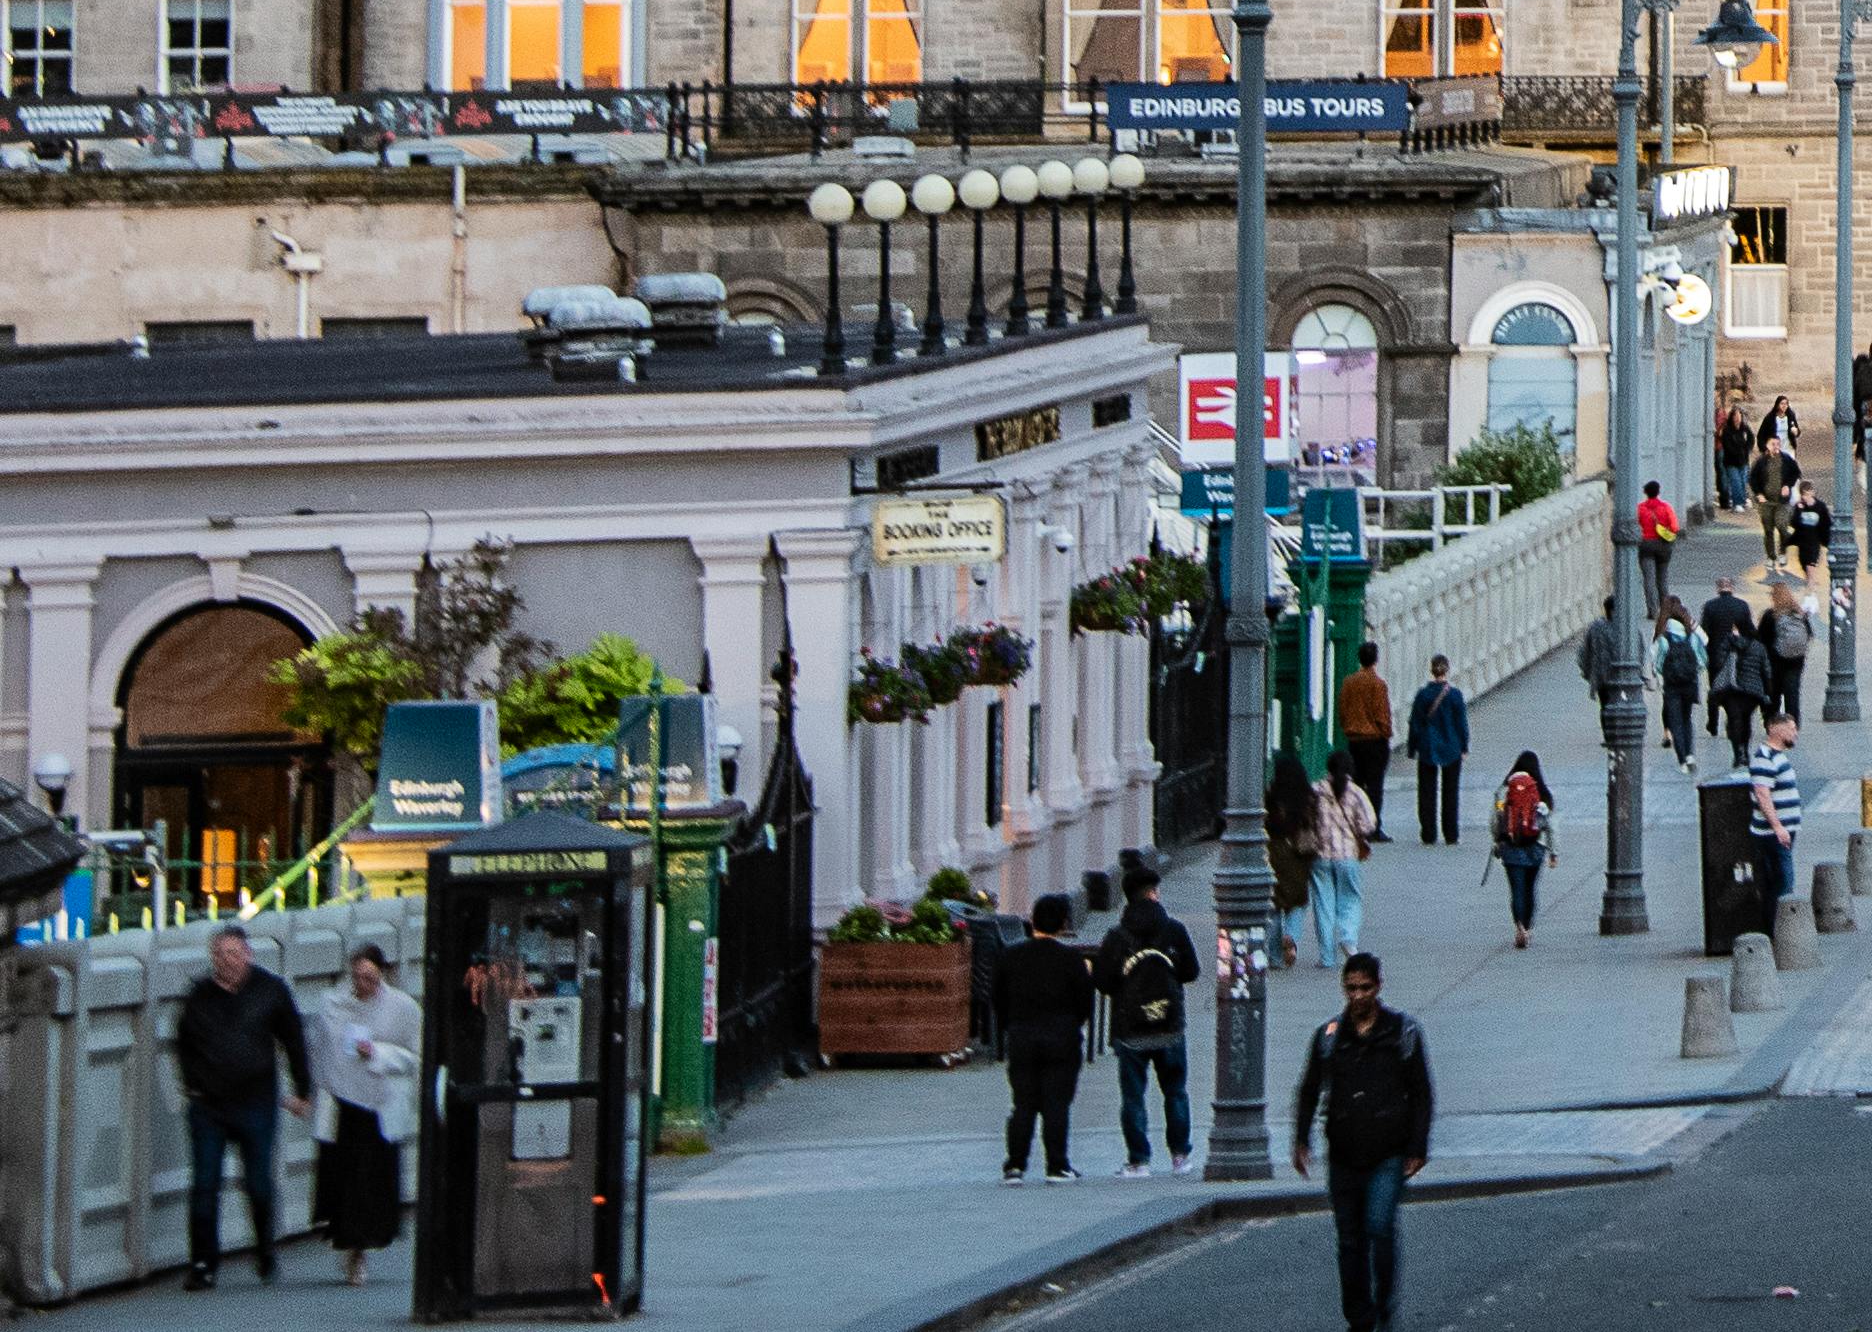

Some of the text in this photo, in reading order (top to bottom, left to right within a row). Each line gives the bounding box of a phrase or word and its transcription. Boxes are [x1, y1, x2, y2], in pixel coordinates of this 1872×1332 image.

[1129, 97, 1385, 118] EDINBURG BUS TOURS
[883, 520, 993, 540] BOOKING OFFICE
[389, 779, 465, 800] Edinburgh
[392, 799, 464, 820] Waverley
